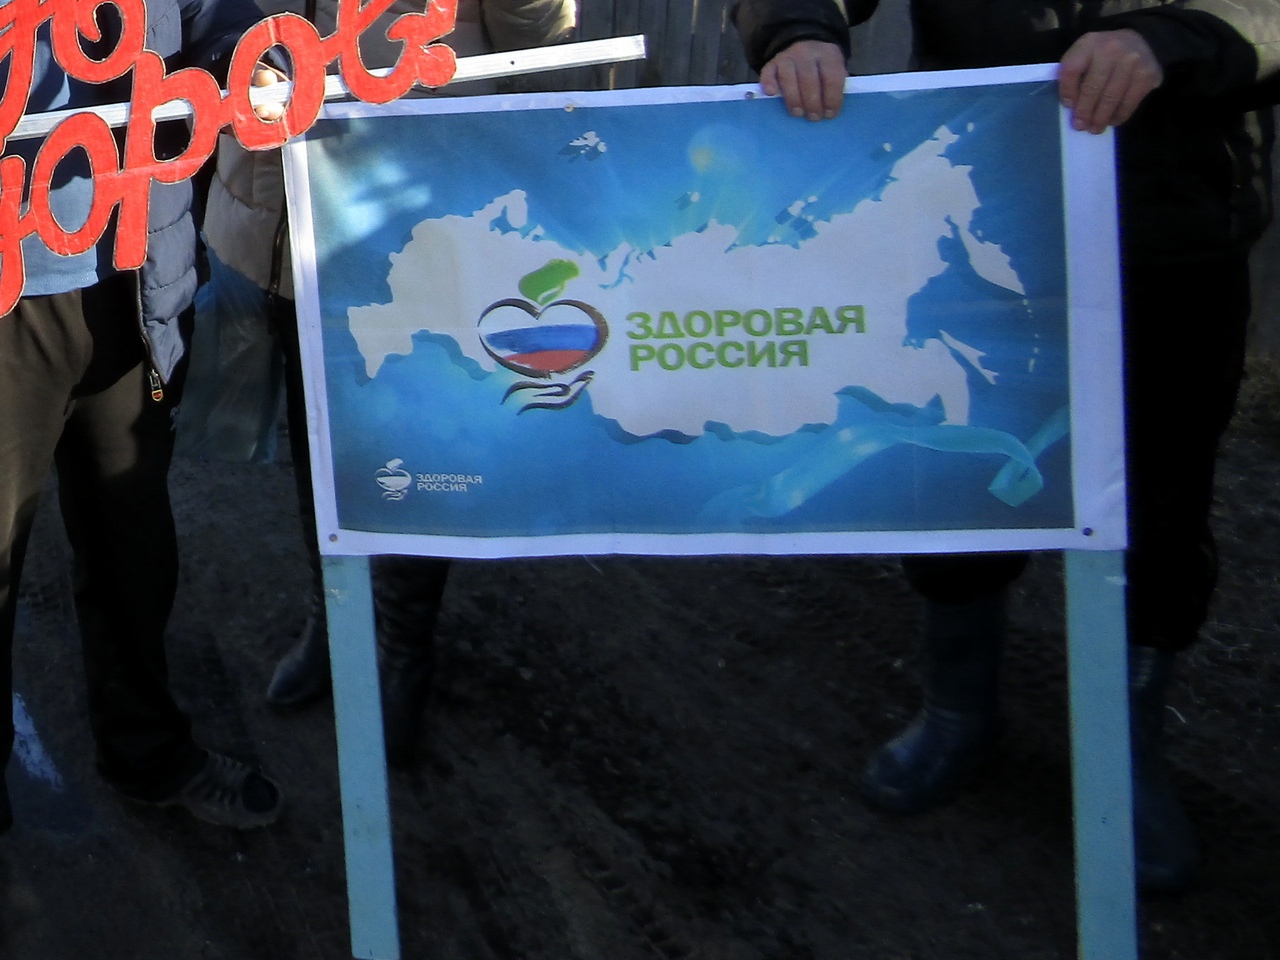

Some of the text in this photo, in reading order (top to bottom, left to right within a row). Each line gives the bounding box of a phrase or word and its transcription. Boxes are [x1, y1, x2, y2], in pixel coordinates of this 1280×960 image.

[625, 305, 865, 340] ЗДОРОВАЯ
[629, 340, 809, 371] РОССИЯ
[416, 473, 483, 484] ЗДОРОВАЯ
[417, 482, 468, 492] РОССИЯ
